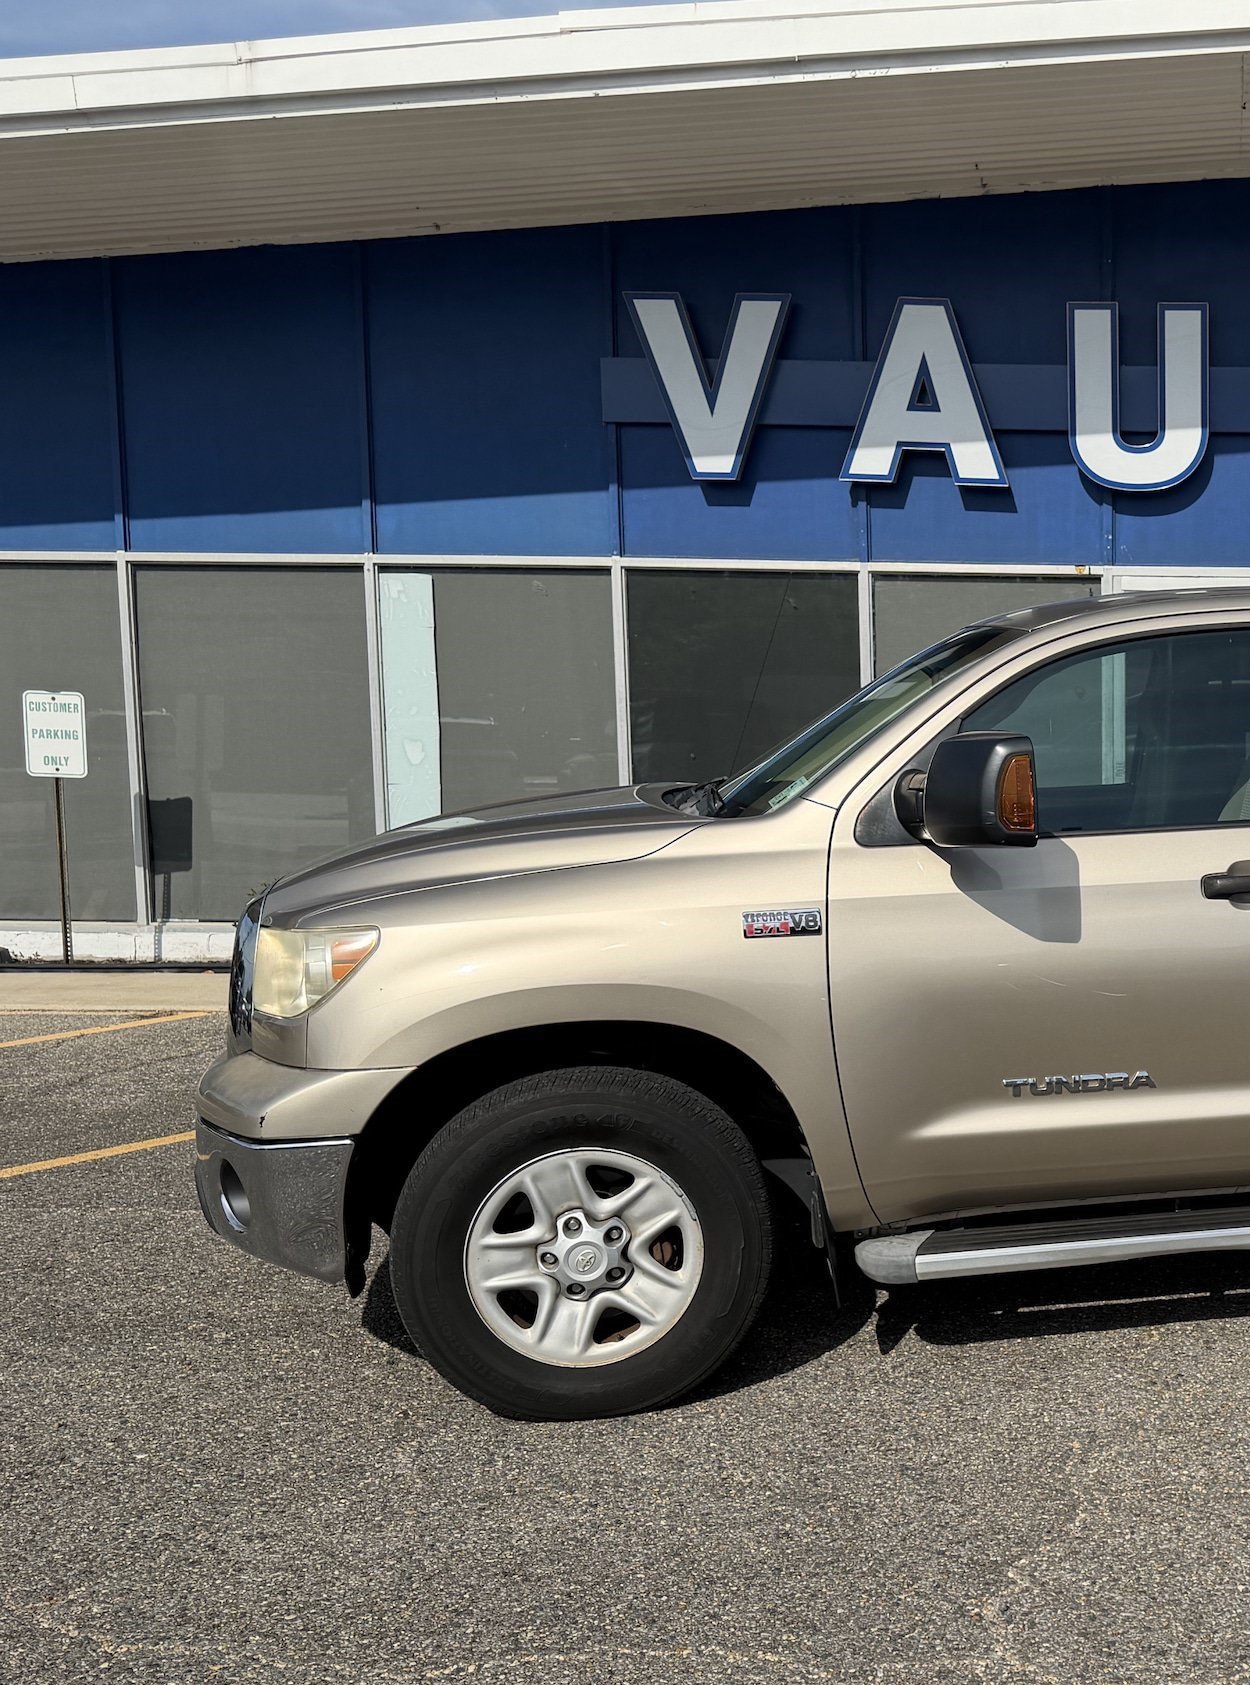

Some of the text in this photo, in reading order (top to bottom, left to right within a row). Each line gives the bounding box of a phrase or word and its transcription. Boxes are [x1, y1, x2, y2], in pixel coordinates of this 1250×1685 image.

[28, 701, 80, 714] CUSTOMER
[31, 728, 79, 741] PARKING
[43, 755, 70, 767] ONLY
[790, 912, 819, 931] V8
[1002, 1070, 1157, 1098] TUNDRA
